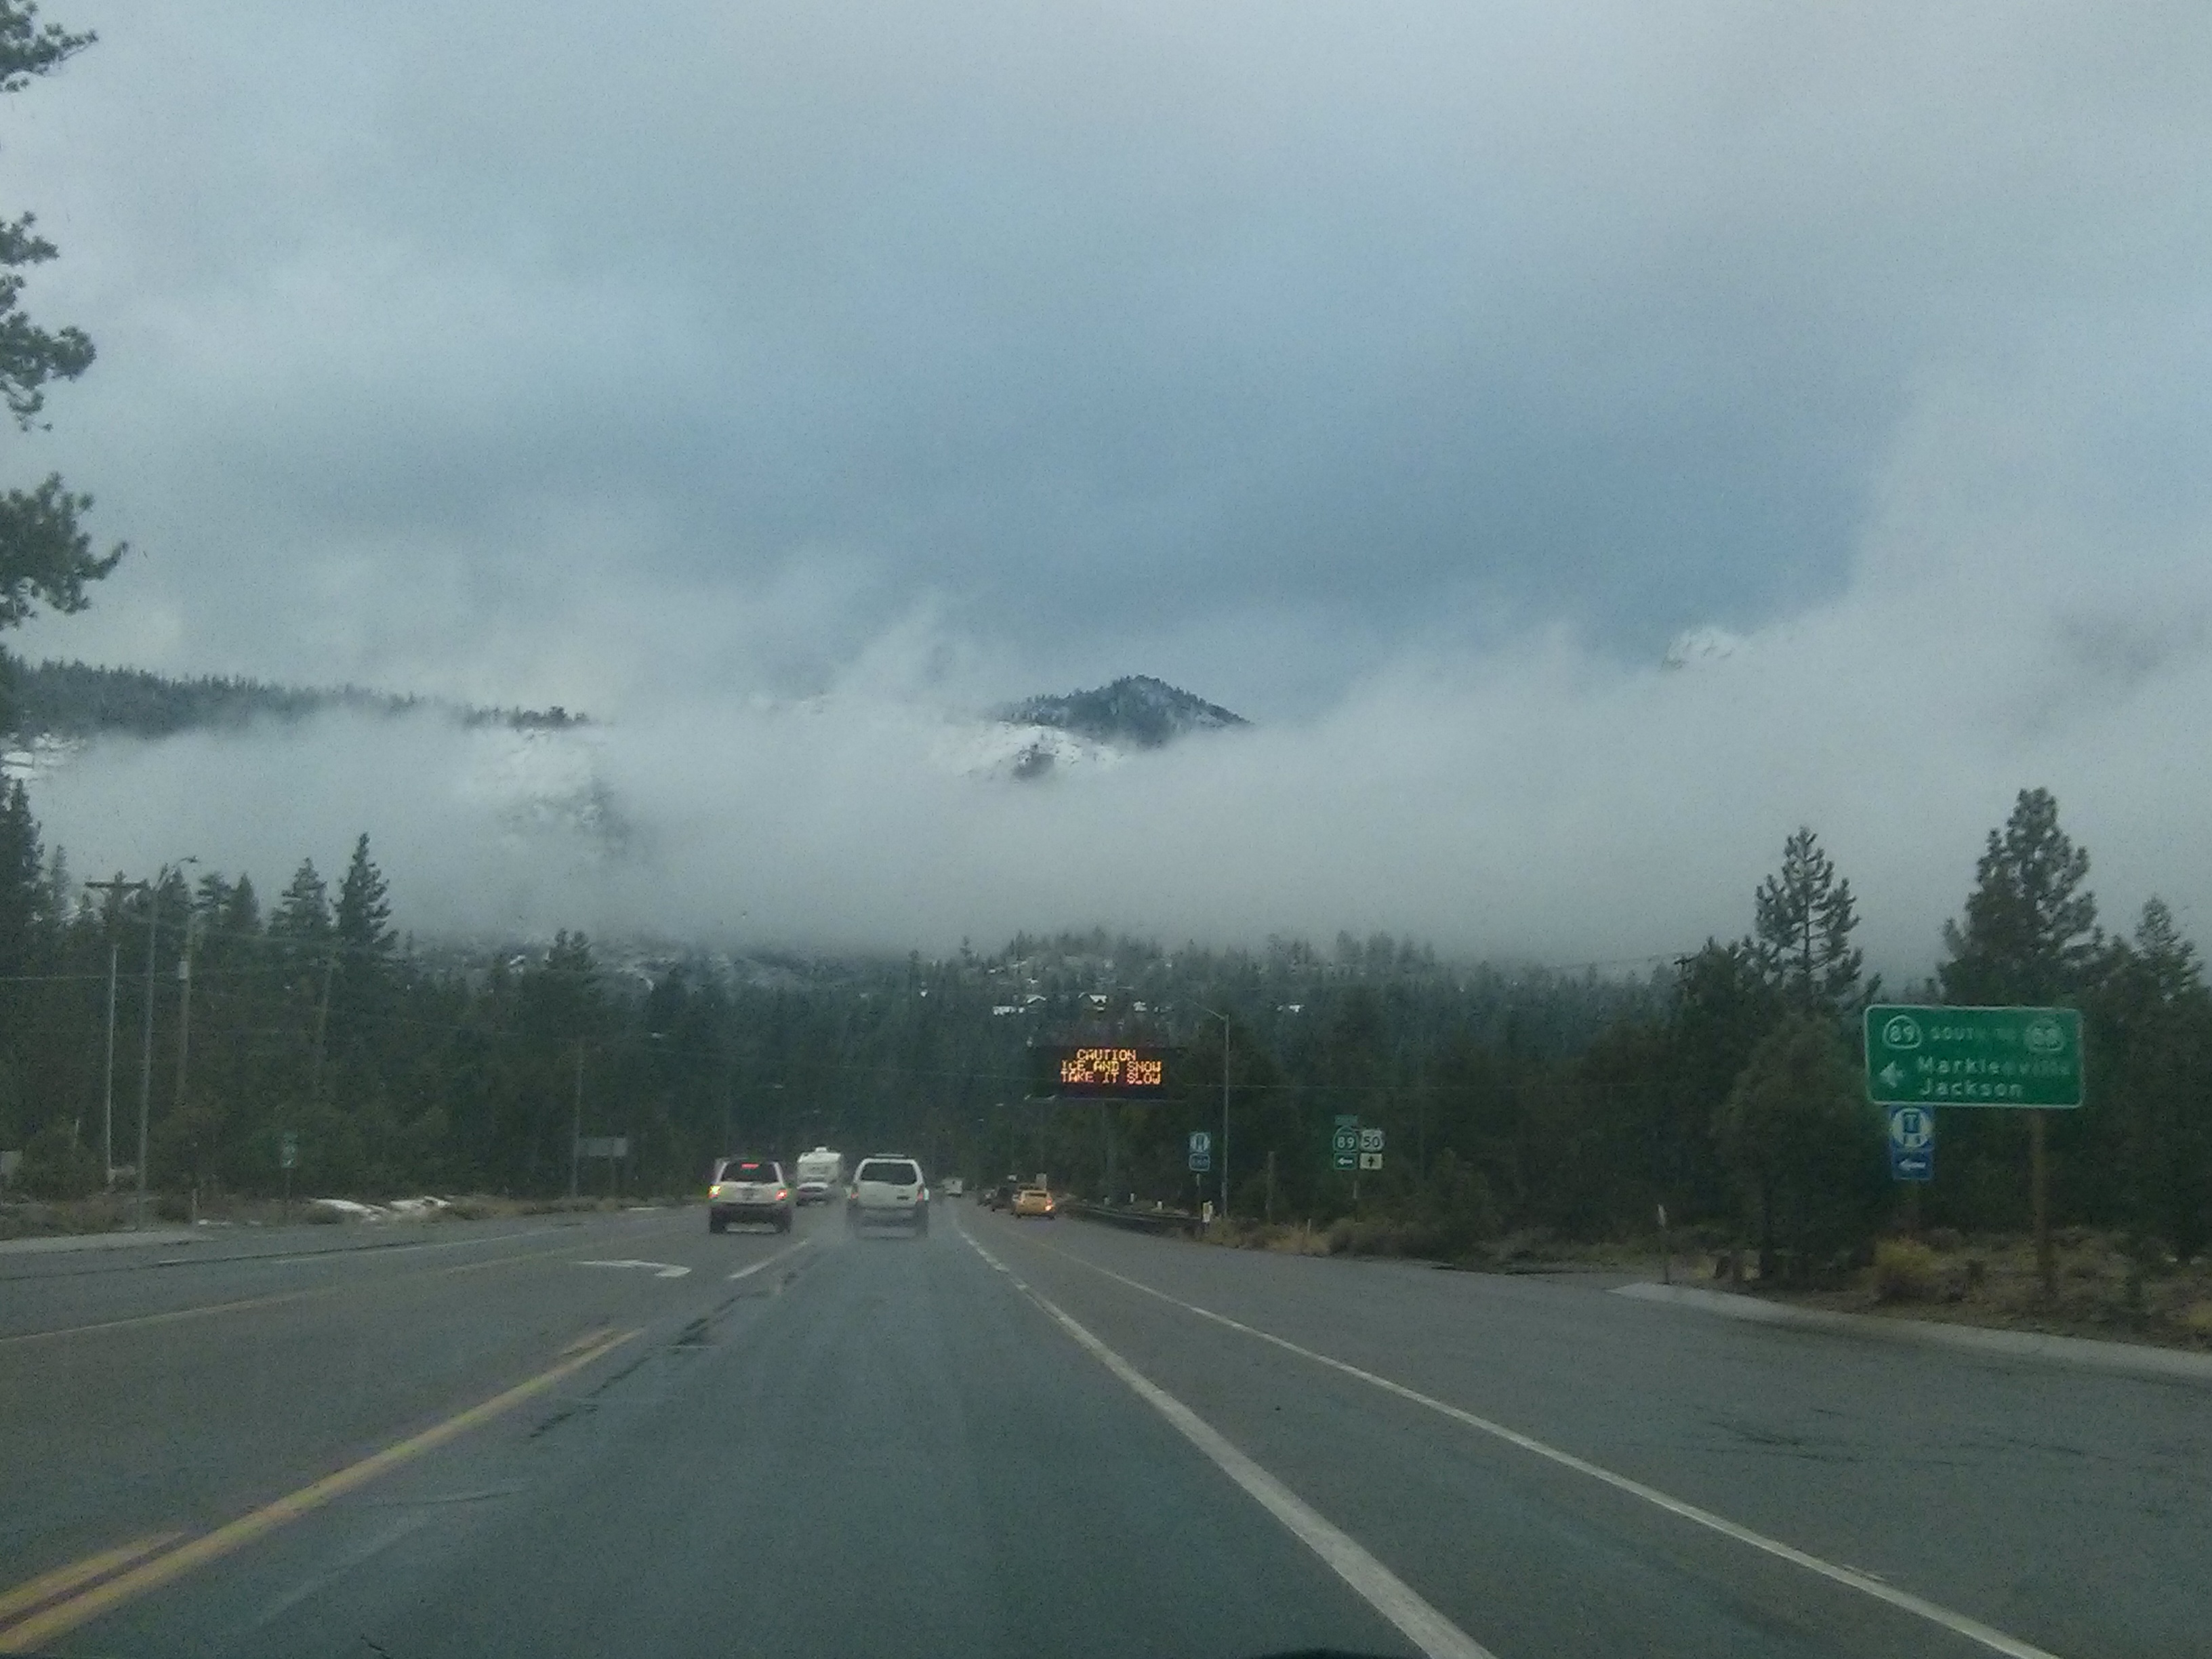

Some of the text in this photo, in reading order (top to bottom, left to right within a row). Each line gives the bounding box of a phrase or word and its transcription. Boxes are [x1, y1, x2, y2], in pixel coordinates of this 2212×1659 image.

[1889, 1025, 1915, 1043] 89
[1076, 1048, 1137, 1061] CAUTION
[1061, 1059, 1162, 1073] ICE AND SNOW
[1060, 1071, 1162, 1085] TAKE IT SLOW
[1919, 1077, 2024, 1098] Jackson
[1337, 1135, 1355, 1149] 89
[1363, 1135, 1381, 1149] 50
